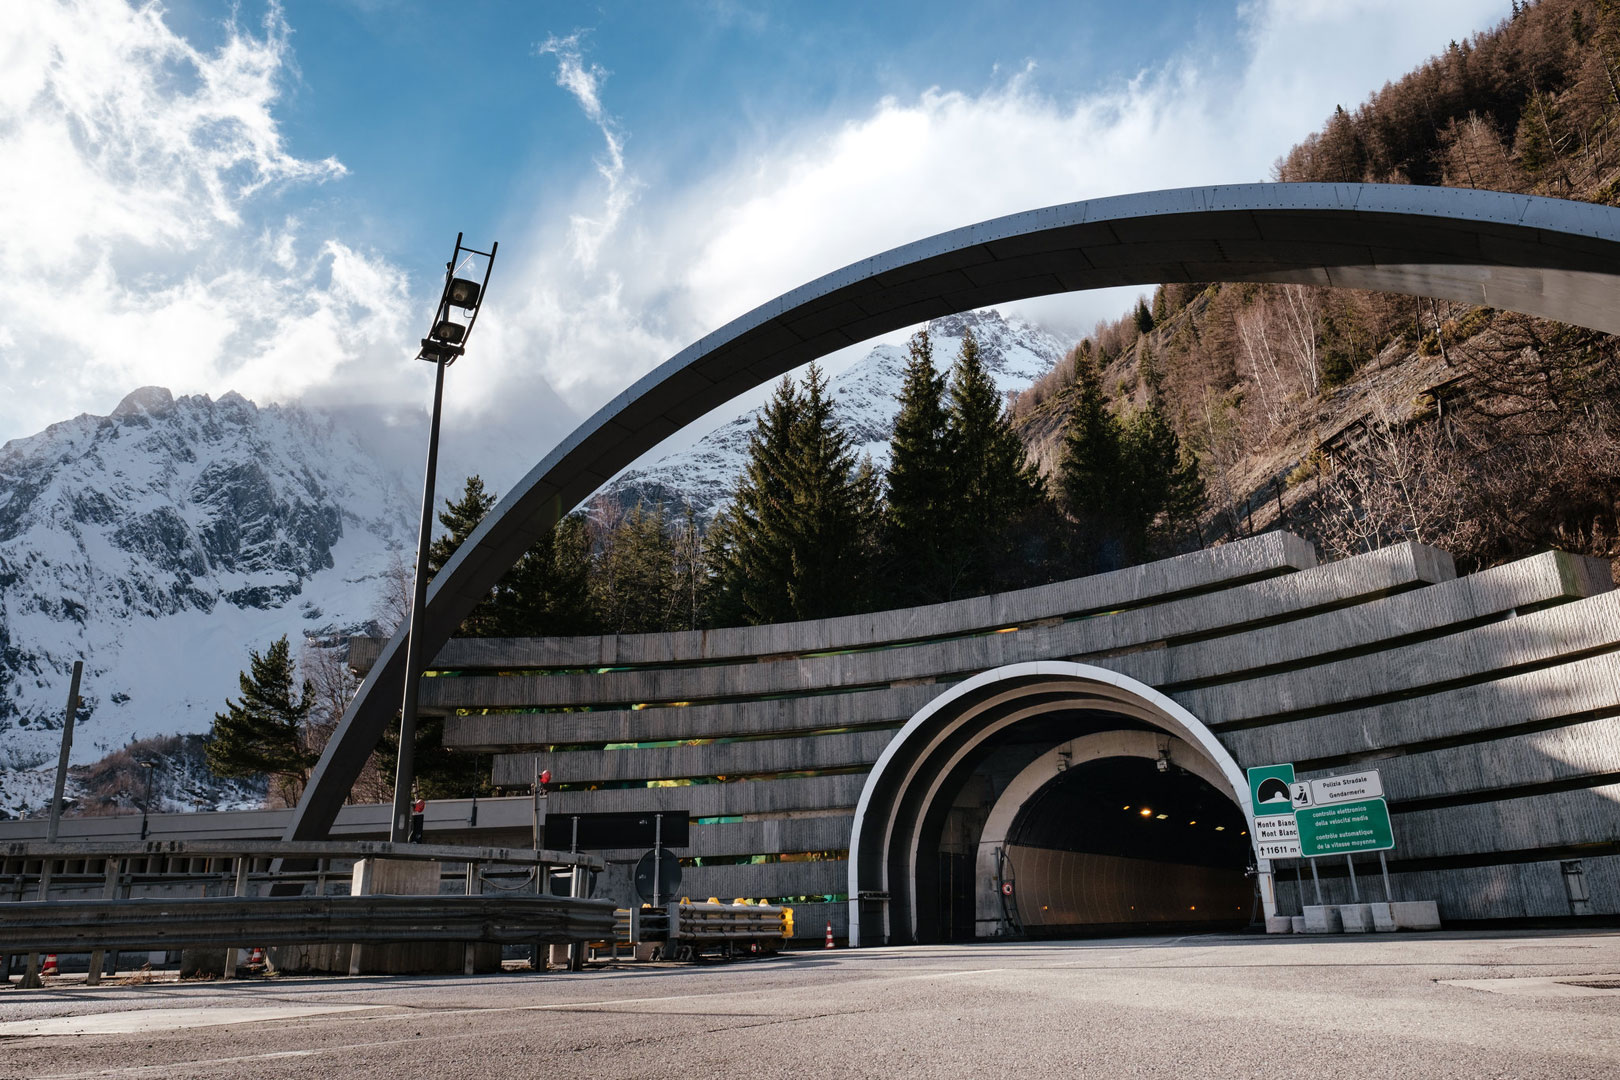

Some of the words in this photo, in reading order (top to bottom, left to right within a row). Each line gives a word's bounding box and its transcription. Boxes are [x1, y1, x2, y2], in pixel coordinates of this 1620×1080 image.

[1342, 777, 1367, 785] Stradale
[1329, 788, 1365, 798] Gendarmerie
[1337, 806, 1367, 815] elettronico
[1277, 819, 1295, 827] Bianc
[1261, 830, 1277, 838] Mont
[1279, 829, 1297, 837] Blanc
[1339, 829, 1374, 838] automatique
[1351, 839, 1376, 847] moyenne
[1266, 845, 1287, 854] 11611
